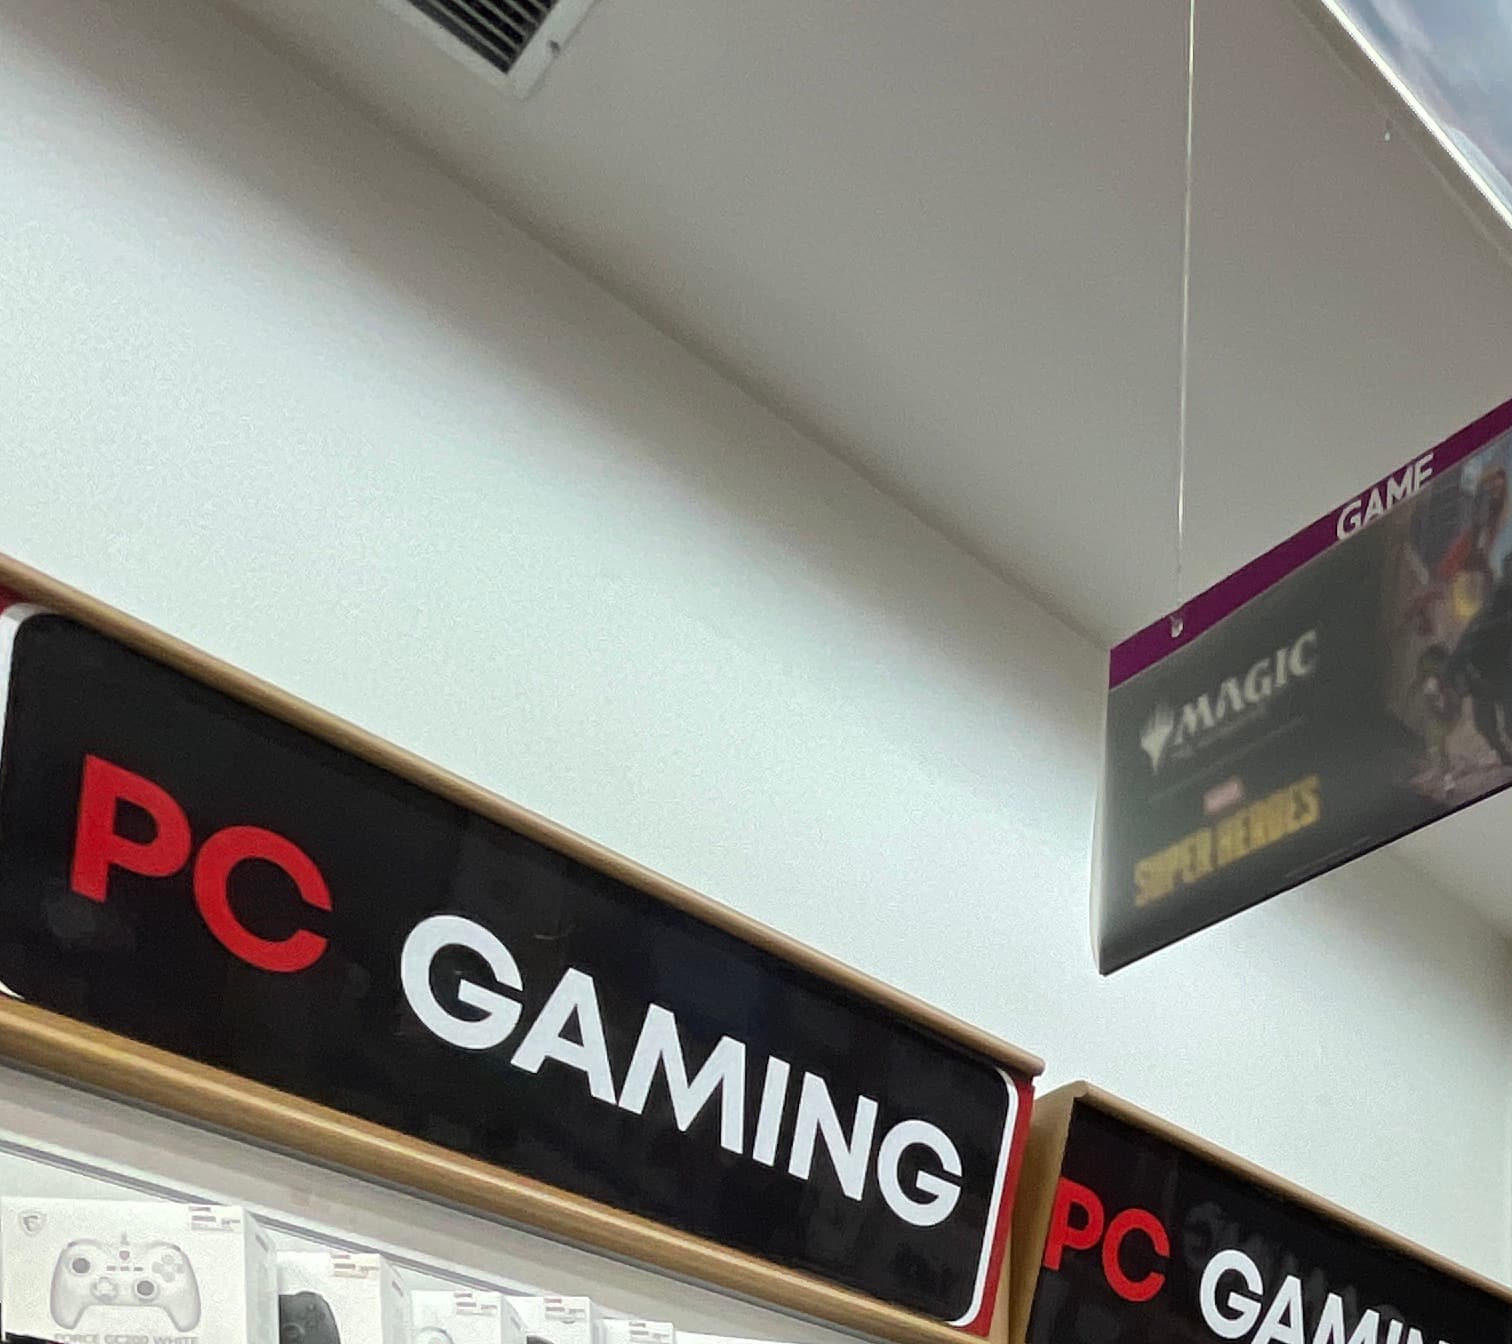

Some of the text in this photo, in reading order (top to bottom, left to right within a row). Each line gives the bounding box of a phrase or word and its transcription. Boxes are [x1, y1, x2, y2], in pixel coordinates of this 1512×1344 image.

[1337, 452, 1433, 540] GAME
[1173, 630, 1317, 745] MAGIC
[70, 754, 963, 1227] PC GAMING
[1043, 1176, 1170, 1301] PC
